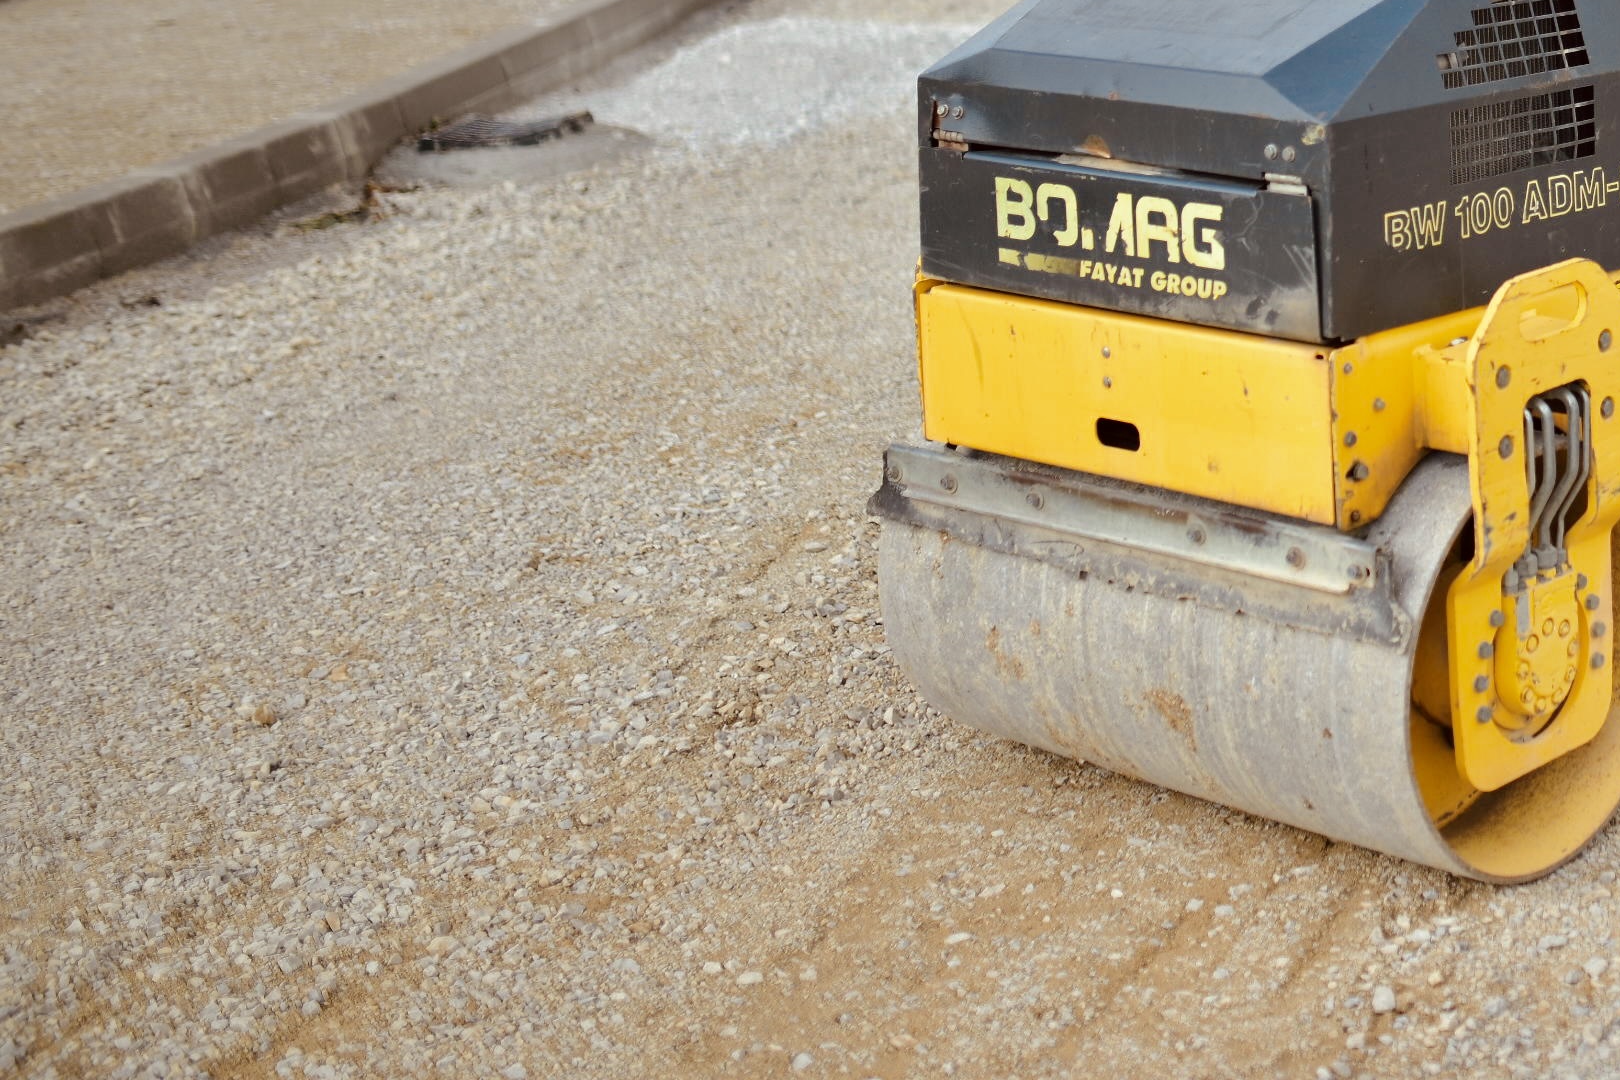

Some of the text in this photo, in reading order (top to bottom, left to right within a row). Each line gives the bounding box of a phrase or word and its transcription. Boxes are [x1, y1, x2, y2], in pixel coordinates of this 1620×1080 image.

[1384, 200, 1447, 250] BW
[1454, 186, 1515, 239] 100
[1080, 259, 1227, 300] FAYAT GROUP
